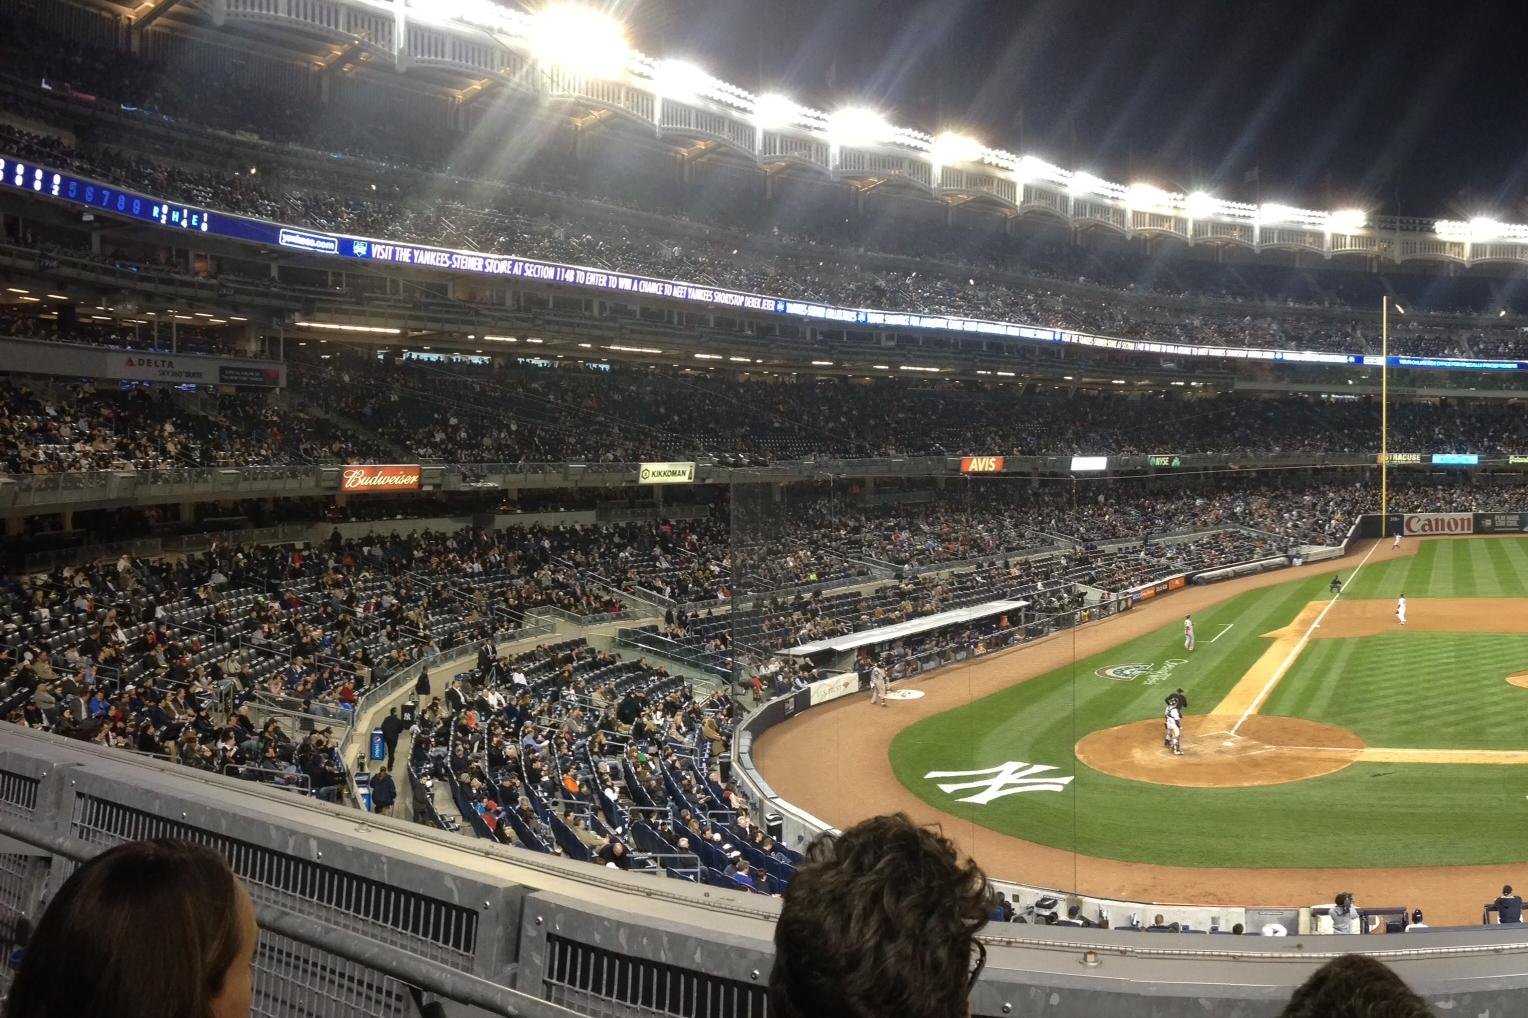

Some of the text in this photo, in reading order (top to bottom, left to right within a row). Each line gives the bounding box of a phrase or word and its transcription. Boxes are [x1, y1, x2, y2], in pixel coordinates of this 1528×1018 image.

[68, 182, 77, 198] 5
[86, 186, 95, 202] 6
[102, 190, 110, 206] 7
[117, 195, 125, 210] 8
[153, 206, 159, 218] R
[172, 211, 179, 222] H
[192, 215, 198, 226] E
[371, 243, 393, 260] VISIT
[395, 246, 412, 263] THE
[485, 259, 512, 274] STORE
[512, 262, 524, 275] AT
[524, 264, 555, 280] SECTION
[576, 269, 585, 284] TO
[585, 271, 607, 287] ENTER
[608, 275, 617, 288] TO
[618, 277, 632, 291] WIN
[632, 279, 638, 292] A
[138, 358, 174, 369] DELTA
[968, 457, 996, 471] AVIS
[1155, 457, 1169, 466] NYSE
[344, 469, 420, 489] Budweiser
[651, 469, 686, 479] KIKKOMAN
[1405, 515, 1472, 533] Canon
